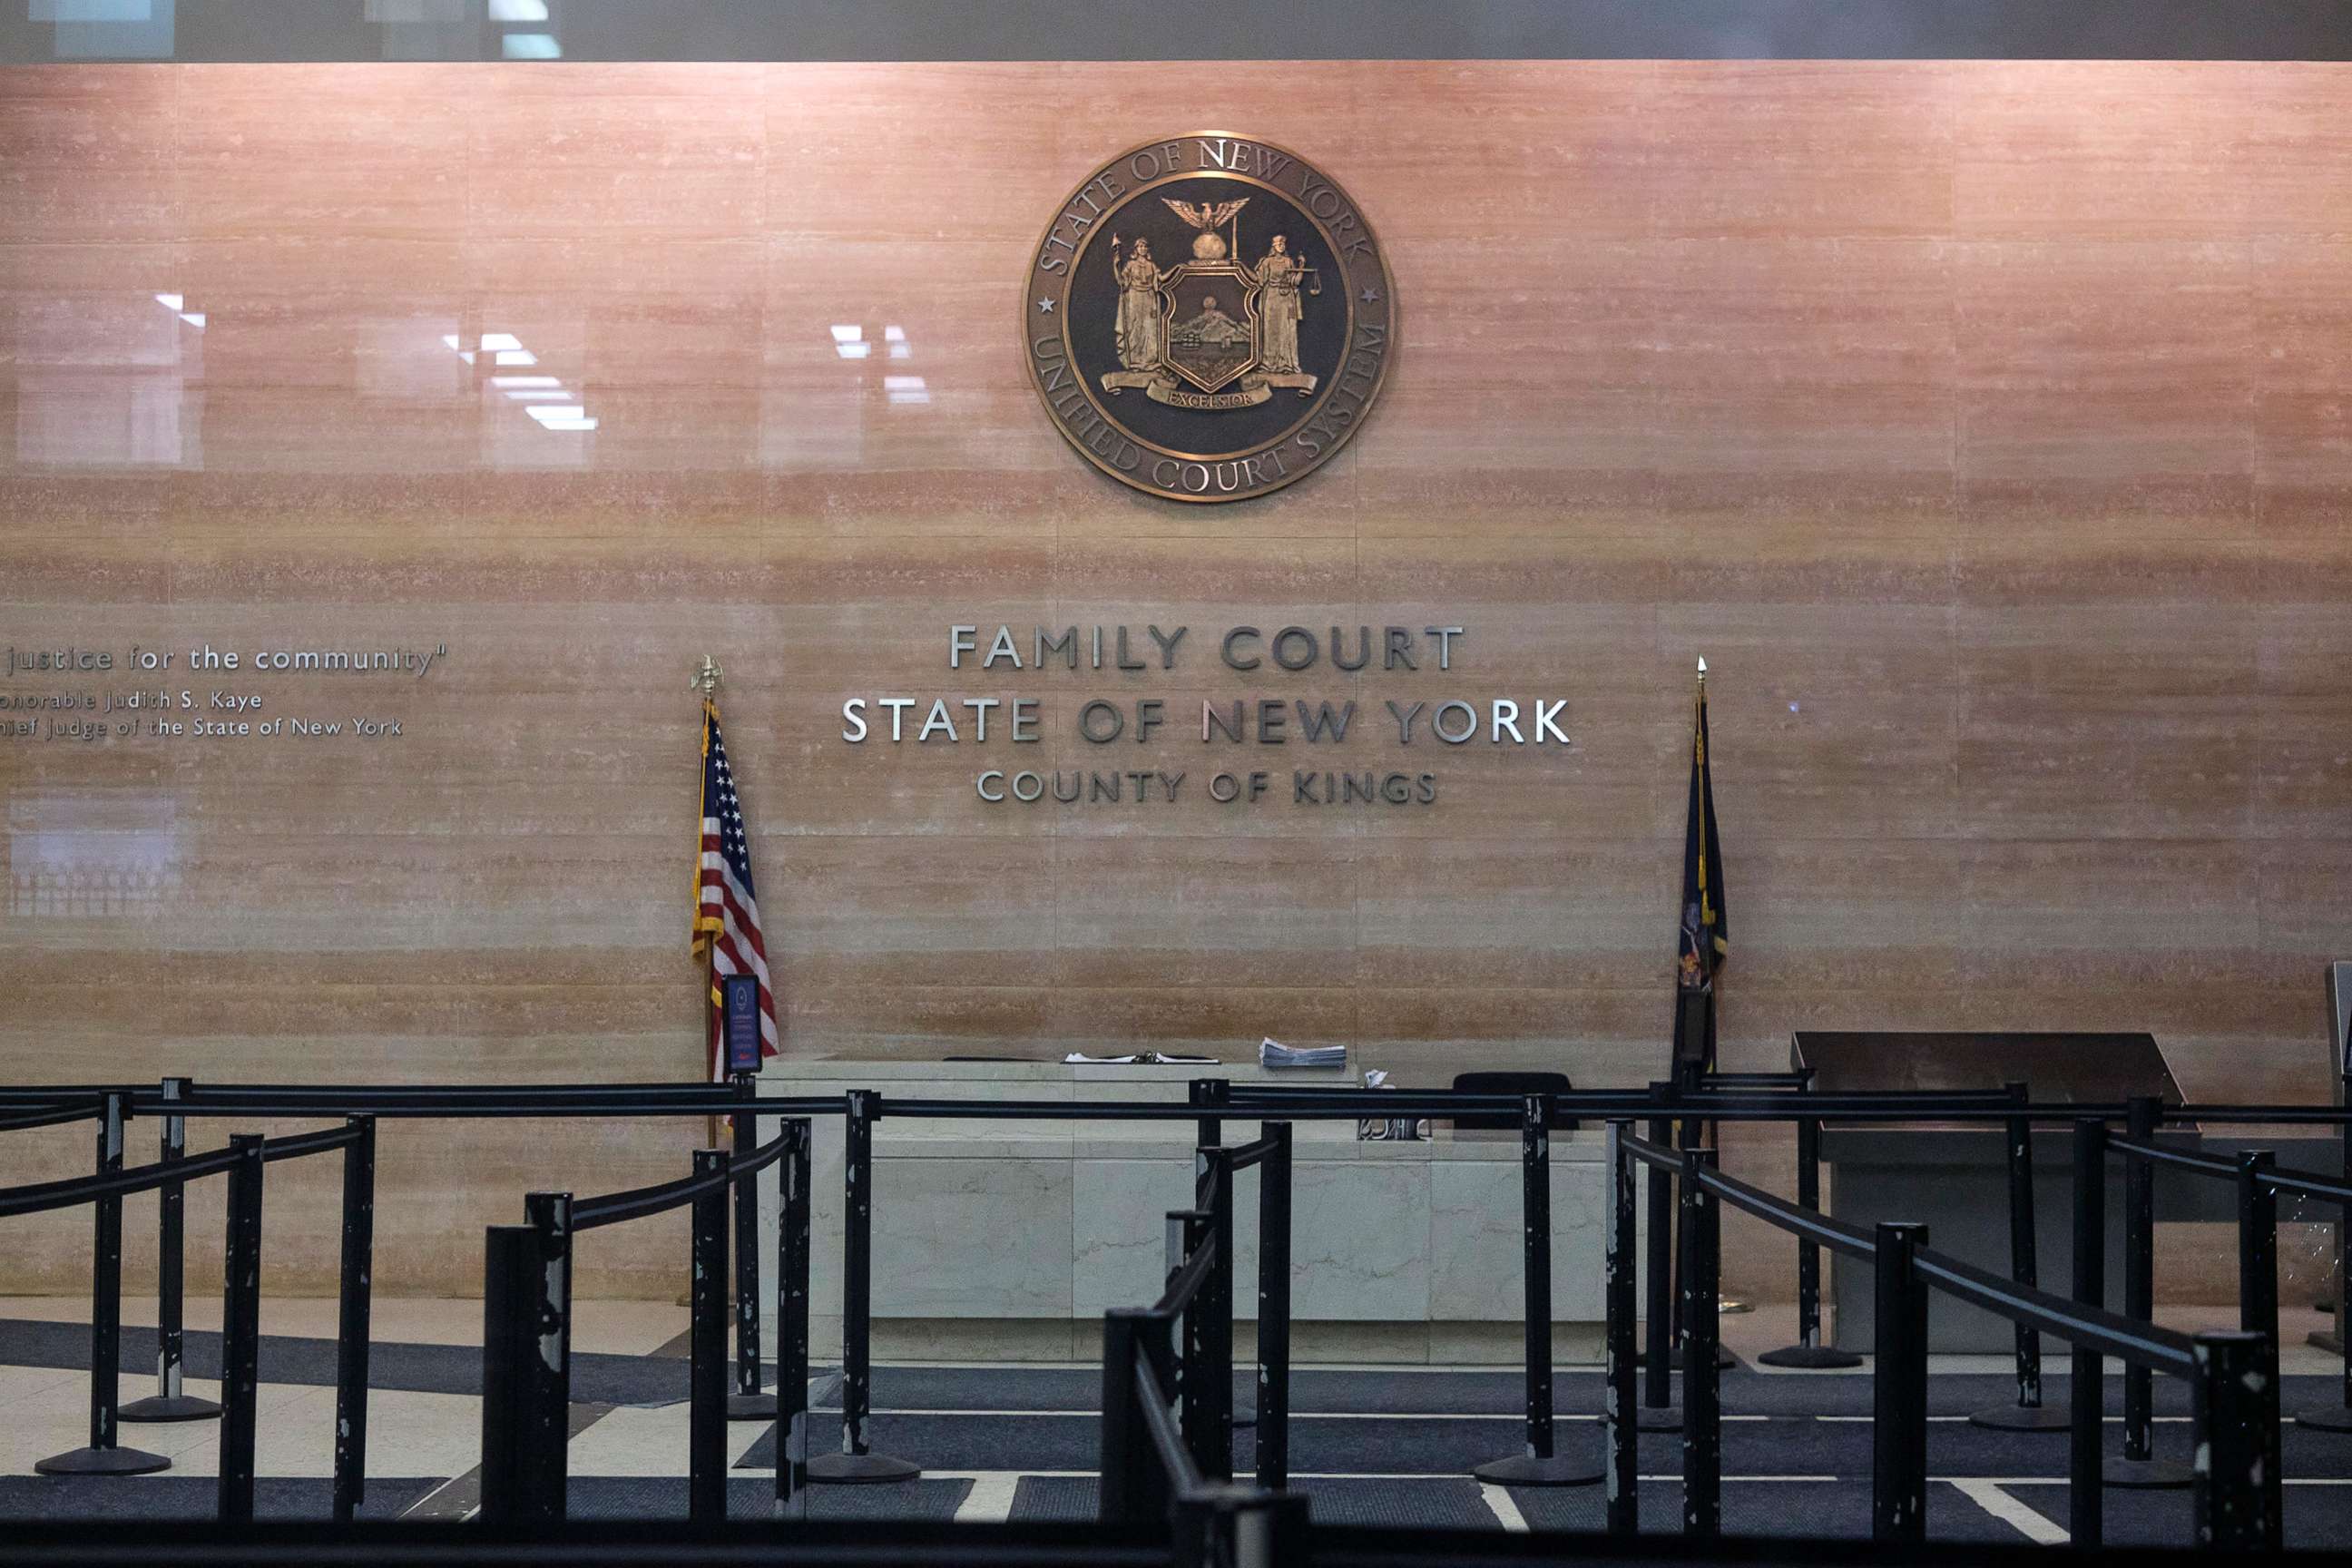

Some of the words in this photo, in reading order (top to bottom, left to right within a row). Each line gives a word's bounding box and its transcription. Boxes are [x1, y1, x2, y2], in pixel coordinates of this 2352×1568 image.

[1040, 171, 1127, 277] STATE
[1131, 142, 1184, 182] OF
[1197, 139, 1292, 183] NEW
[1298, 171, 1375, 264] YORK
[1034, 334, 1141, 472] UNIFIED
[1152, 446, 1289, 493] COURT
[1295, 321, 1387, 458] SYSTEM
[1167, 391, 1254, 408] EXCELSIOR
[6, 646, 113, 676] justice
[128, 645, 175, 670] for
[190, 644, 240, 670] the
[949, 624, 1188, 671] FAMILY
[1221, 624, 1464, 671] COURT
[104, 689, 172, 712] Judith
[181, 690, 200, 709] S.
[211, 690, 262, 712] Kaye
[45, 717, 107, 740] Judge
[116, 717, 139, 736] of
[150, 717, 183, 736] the
[193, 718, 250, 737] State
[260, 717, 281, 736] of
[291, 717, 341, 736] New
[352, 717, 403, 736] York
[841, 698, 1040, 743] STATE
[1081, 698, 1165, 744] OF
[1201, 698, 1357, 744] NEW
[1385, 698, 1572, 744] YORK
[975, 769, 1188, 803] COUNTY
[1209, 769, 1269, 803] OF
[1293, 769, 1436, 803] KINGS
